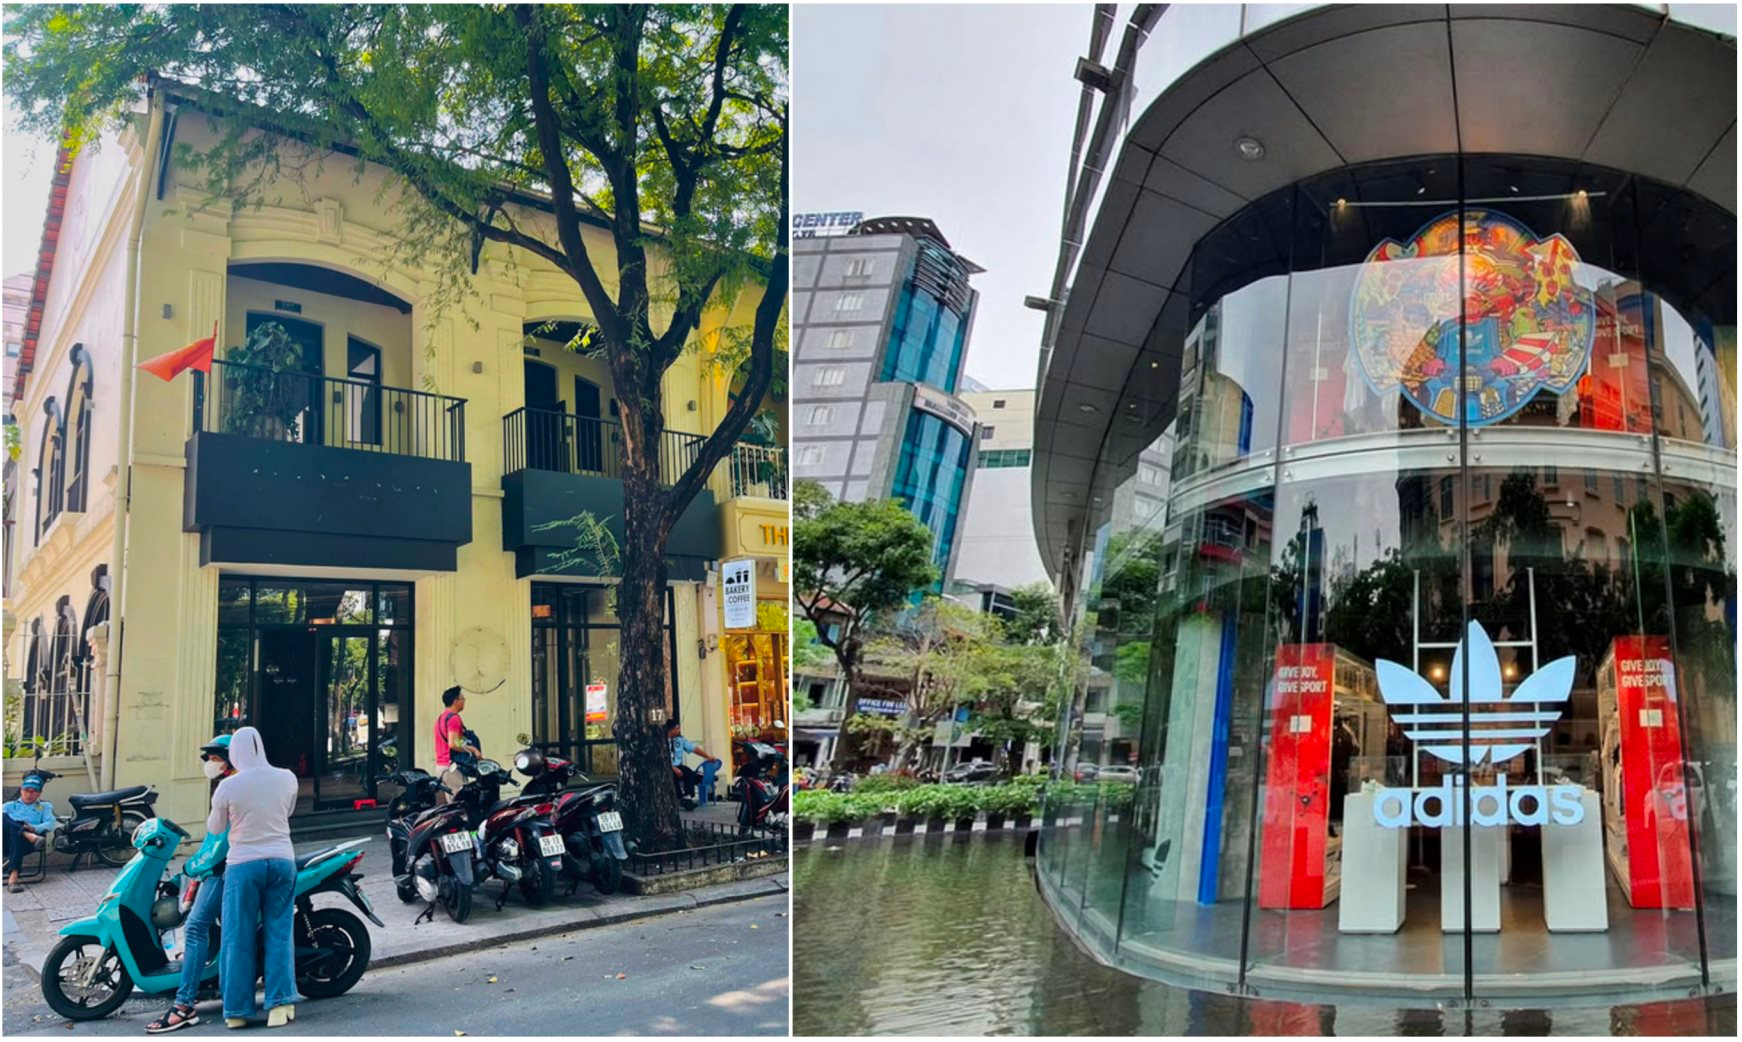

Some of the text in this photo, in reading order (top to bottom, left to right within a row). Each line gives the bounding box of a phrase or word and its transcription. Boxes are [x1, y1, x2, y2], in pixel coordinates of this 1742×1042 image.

[793, 211, 863, 228] CENTER
[759, 523, 788, 546] TH
[725, 584, 750, 594] BAKERY
[728, 594, 750, 604] COFFEE
[1279, 666, 1299, 678] GIVE
[1621, 659, 1643, 672] GIVE
[1278, 680, 1328, 693] GIVE SPORT
[1622, 674, 1645, 688] GIVE
[651, 709, 663, 721] 17
[1373, 773, 1585, 829] adidas
